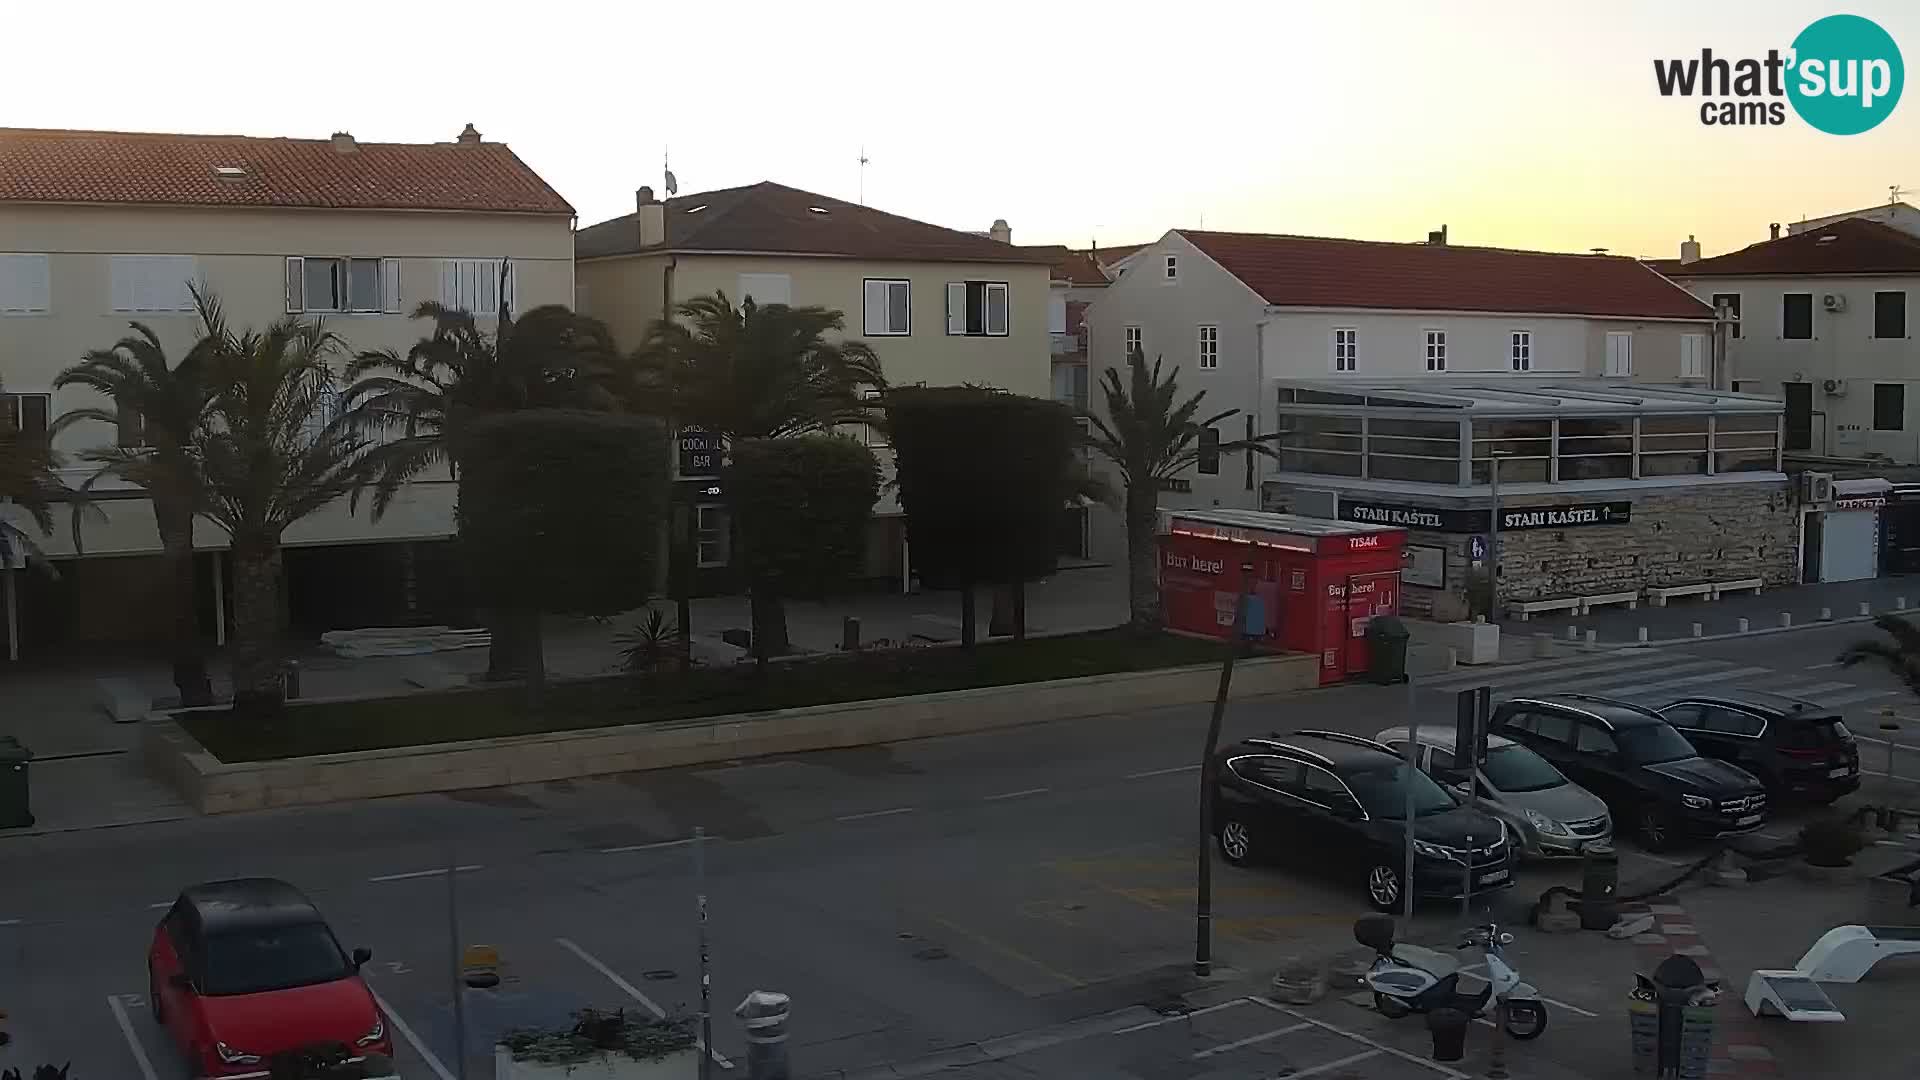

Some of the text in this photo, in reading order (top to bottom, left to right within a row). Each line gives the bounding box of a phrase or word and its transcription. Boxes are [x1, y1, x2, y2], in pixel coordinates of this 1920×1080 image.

[693, 455, 711, 467] BAR
[1353, 506, 1442, 527] STARI KAŠTEL
[1504, 507, 1598, 527] STARI KAŠTEL
[1349, 535, 1378, 549] TISAK
[1192, 554, 1224, 575] here!
